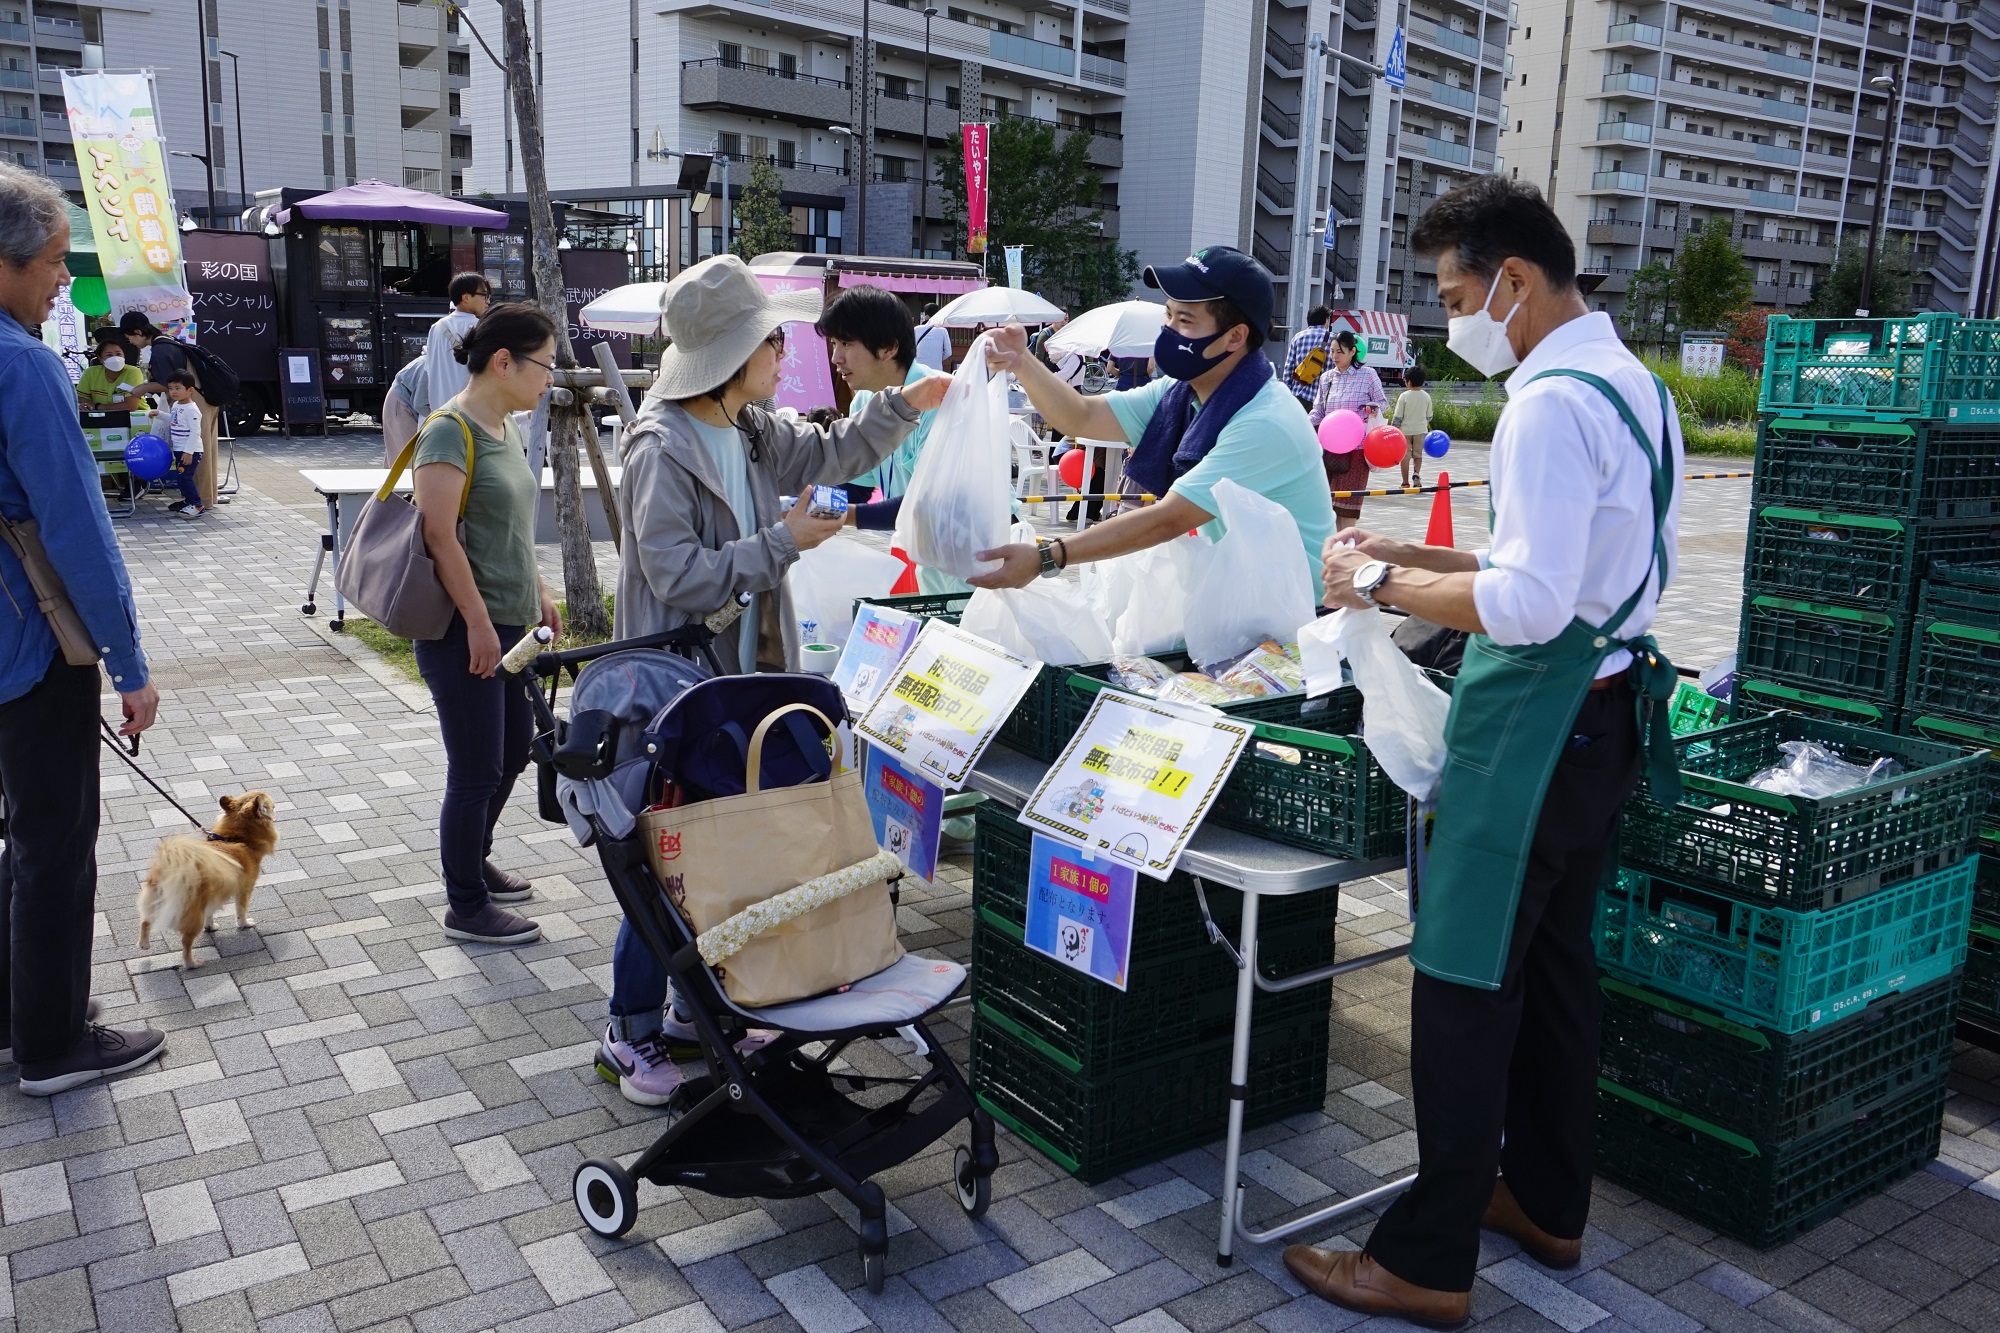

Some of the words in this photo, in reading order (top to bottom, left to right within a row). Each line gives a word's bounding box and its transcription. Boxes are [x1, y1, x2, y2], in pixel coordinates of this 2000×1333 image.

[201, 261, 259, 282] 彩の国
[508, 279, 526, 290] ¥500
[191, 292, 274, 310] スペシャル
[203, 320, 267, 336] スイーツ
[1371, 341, 1386, 351] TOLL
[927, 654, 991, 697] 防災用品
[1120, 728, 1184, 763] 防災用品
[1053, 863, 1109, 896] 1家族1個の
[1038, 886, 1111, 930] 配布となります。
